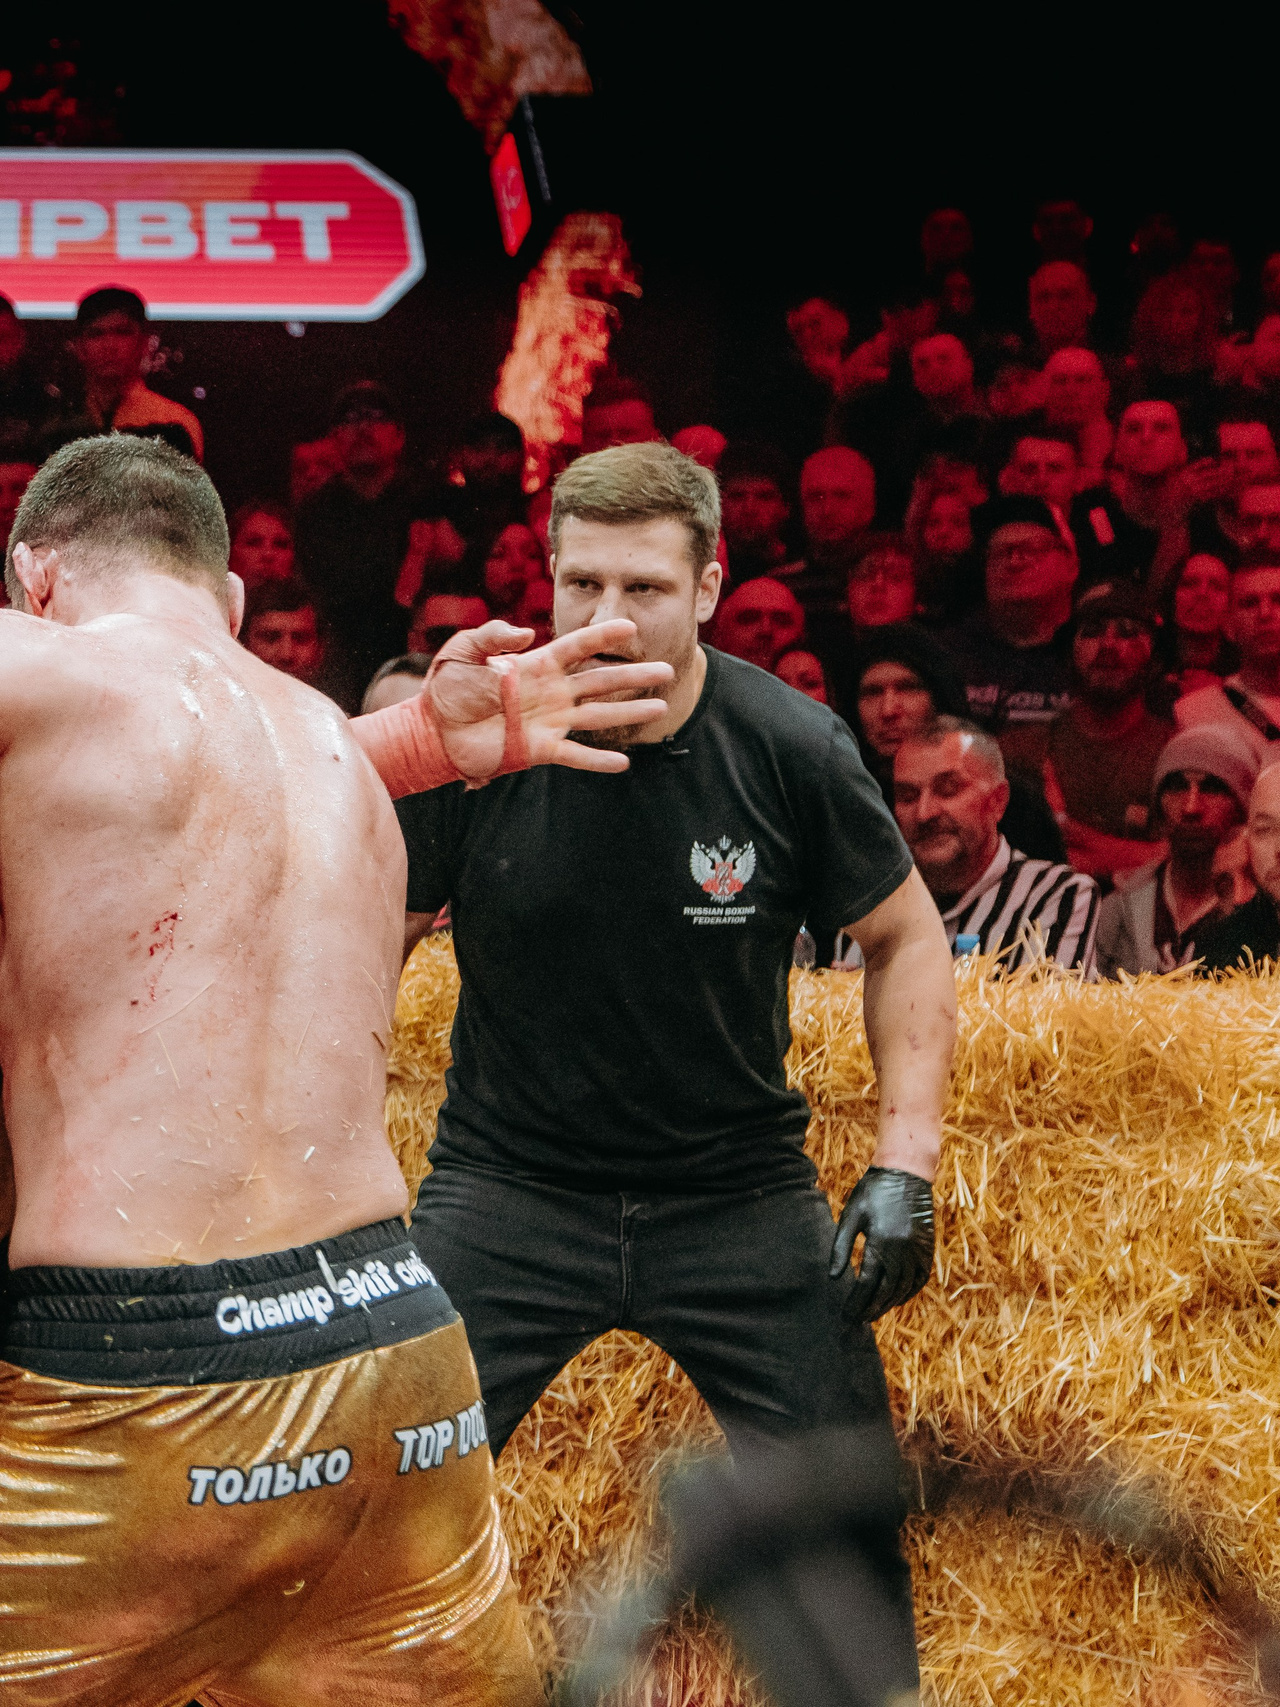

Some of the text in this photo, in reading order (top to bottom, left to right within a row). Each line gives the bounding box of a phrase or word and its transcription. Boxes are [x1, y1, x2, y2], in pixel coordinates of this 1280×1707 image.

[683, 905, 756, 916] RUSSIAN BOXING
[692, 916, 747, 925] FEDERATION
[216, 1286, 334, 1334] Champ
[394, 1420, 455, 1475] TOP
[188, 1446, 352, 1505] ТОЛЬКО
